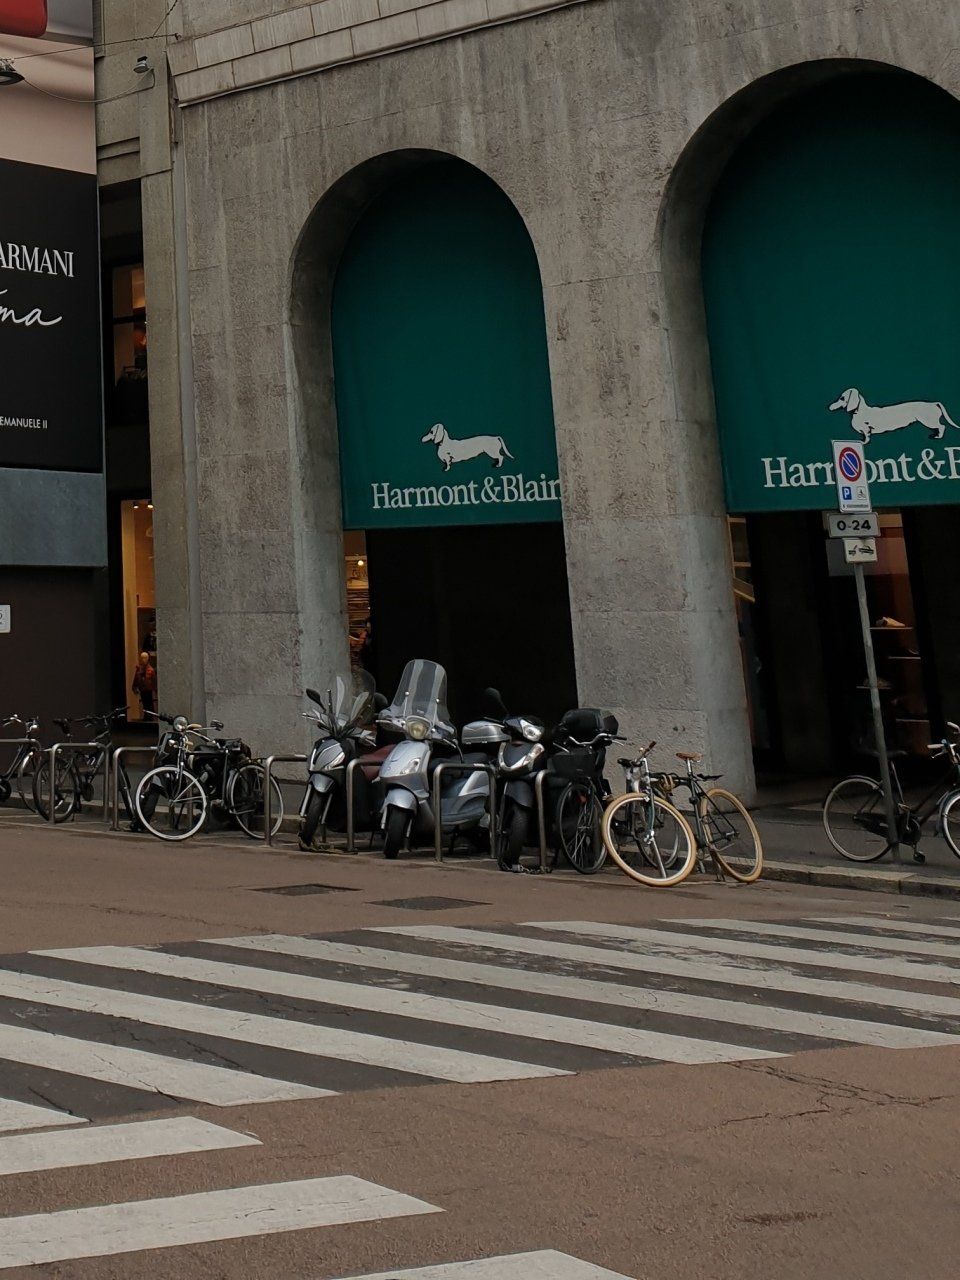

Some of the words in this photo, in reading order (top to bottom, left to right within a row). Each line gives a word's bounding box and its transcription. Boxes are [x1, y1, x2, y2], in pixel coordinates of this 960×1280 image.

[0, 415, 41, 429] EMANUELE
[42, 419, 48, 429] II
[836, 519, 872, 532] 0-24
